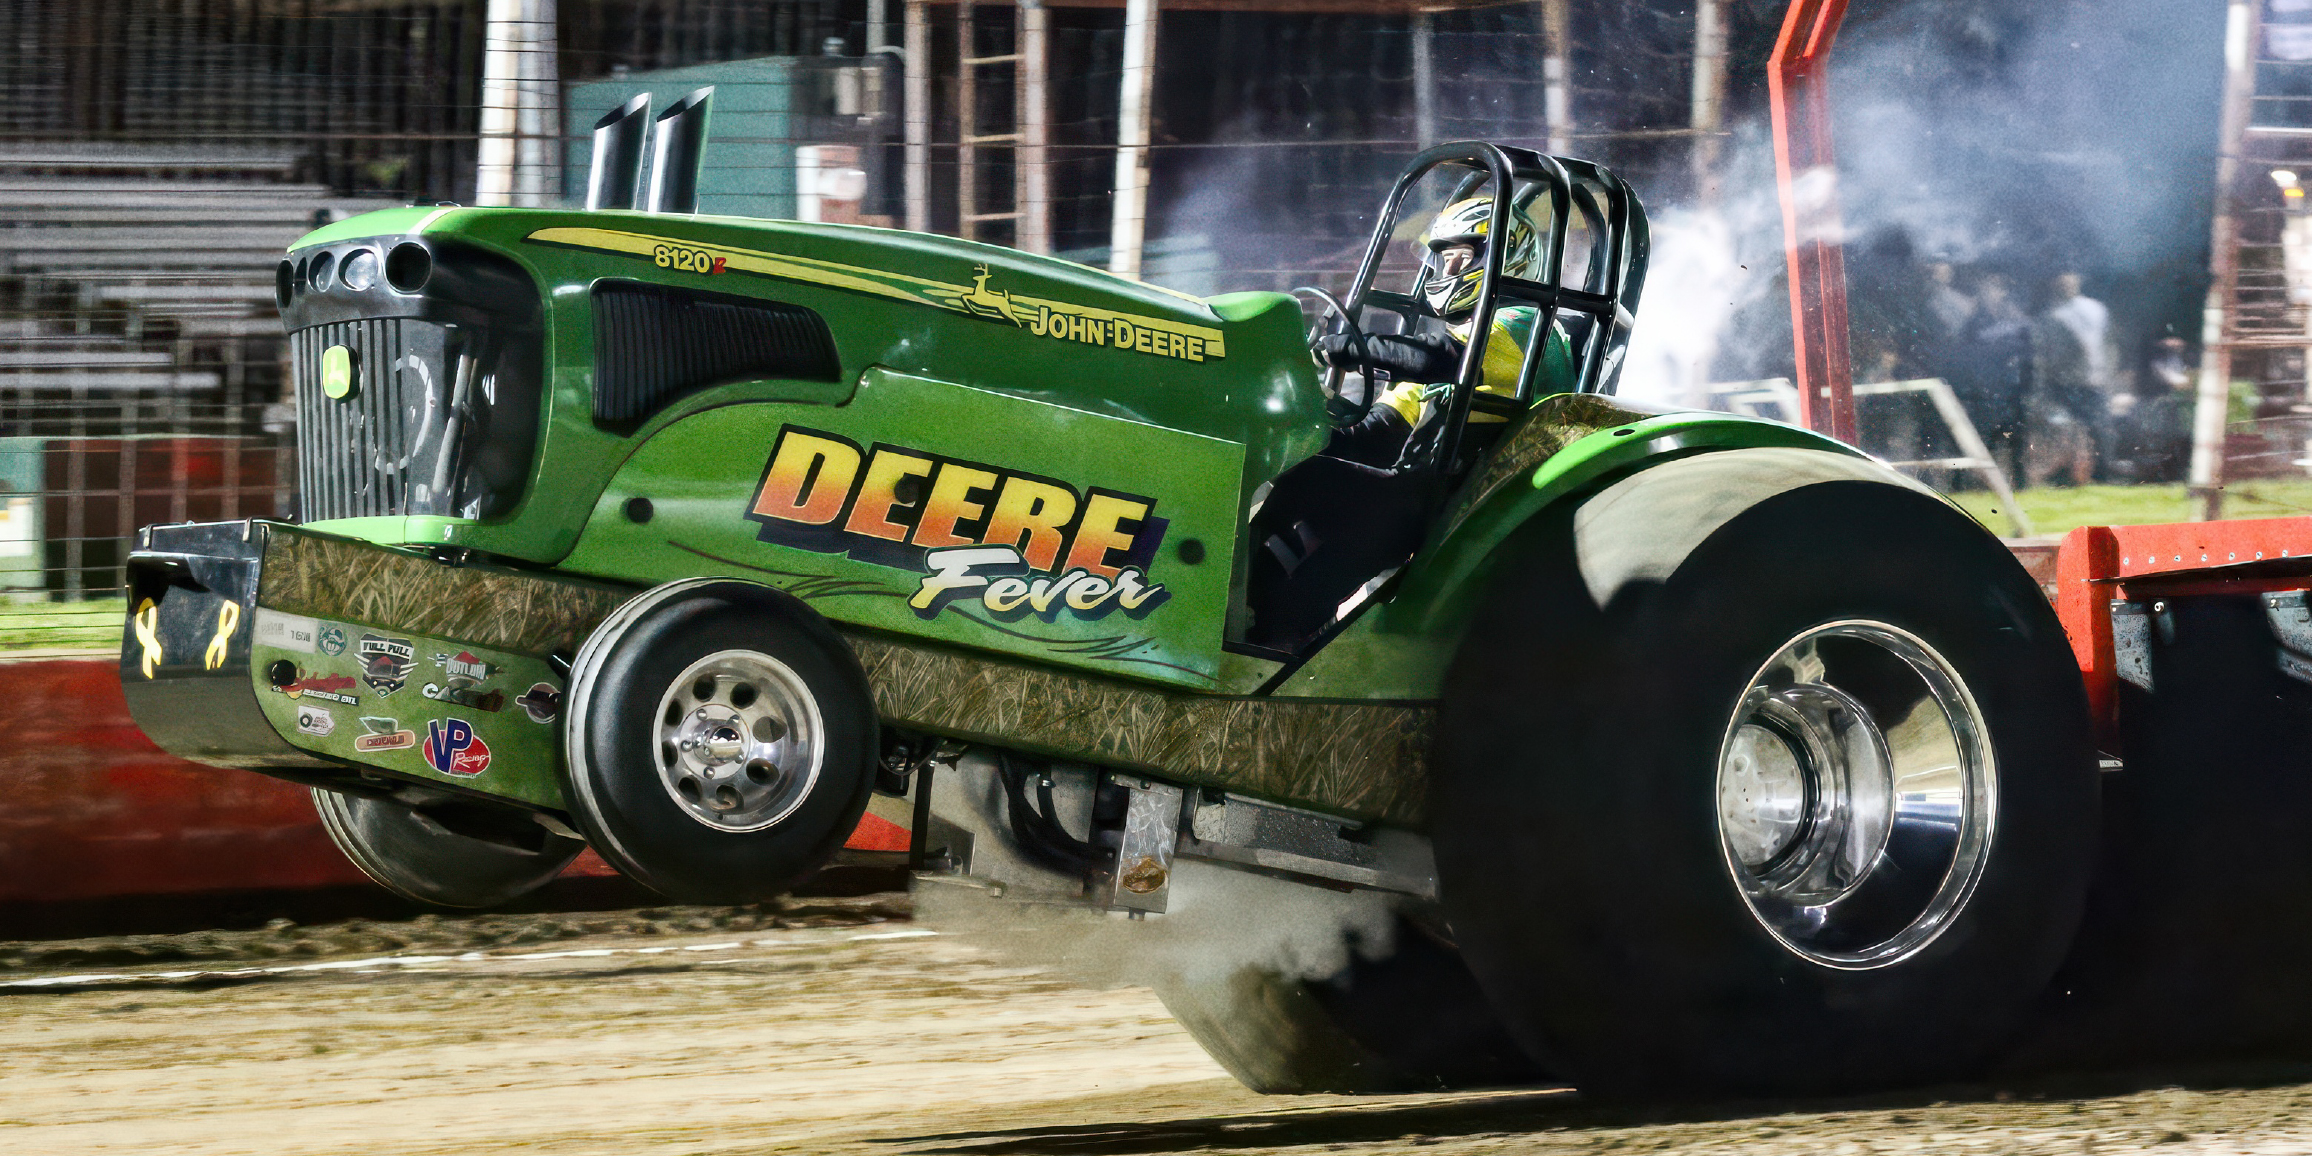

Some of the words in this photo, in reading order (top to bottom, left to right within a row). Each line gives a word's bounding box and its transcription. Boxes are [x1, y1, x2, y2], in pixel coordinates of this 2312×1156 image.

[1029, 305, 1106, 347] JOHN
[1113, 317, 1205, 363] DEERE
[745, 424, 1158, 577] DEERE
[907, 544, 1166, 616] Fever
[387, 643, 410, 658] PULL
[445, 656, 487, 681] OUTLAW
[427, 717, 474, 775] VP
